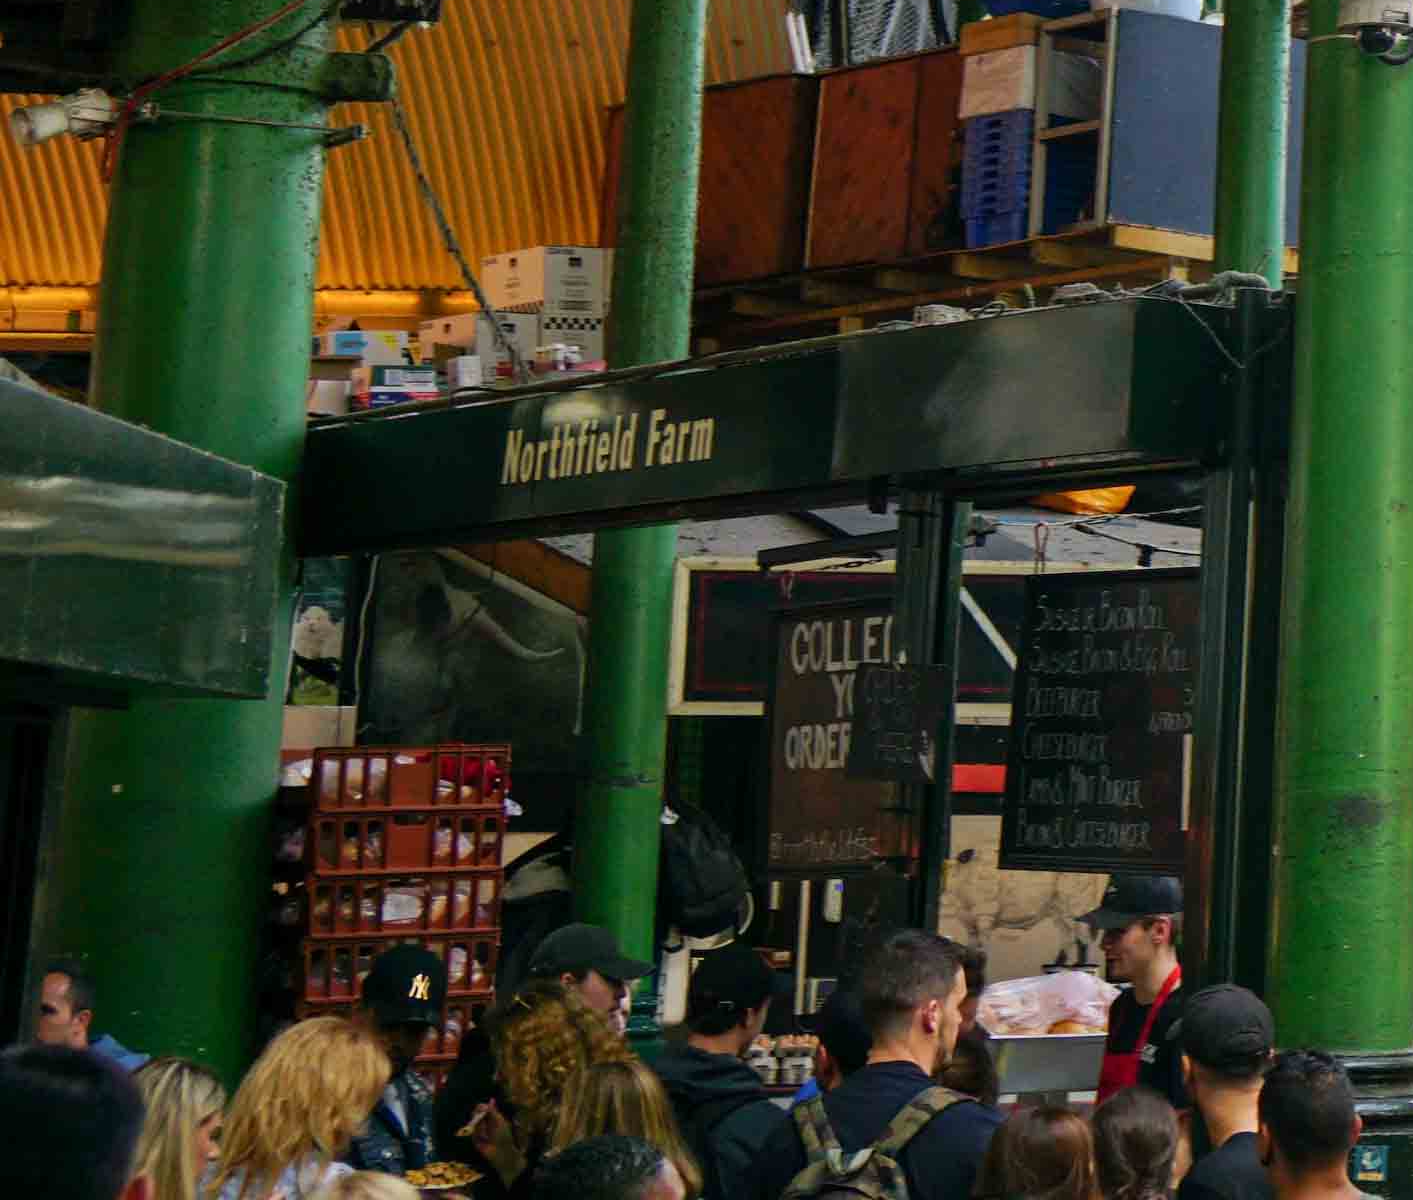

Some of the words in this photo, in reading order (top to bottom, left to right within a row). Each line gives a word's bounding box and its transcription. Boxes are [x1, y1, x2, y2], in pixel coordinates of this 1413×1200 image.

[501, 412, 639, 485] Northfield
[645, 407, 715, 468] Farm
[790, 613, 909, 674] COLLEC
